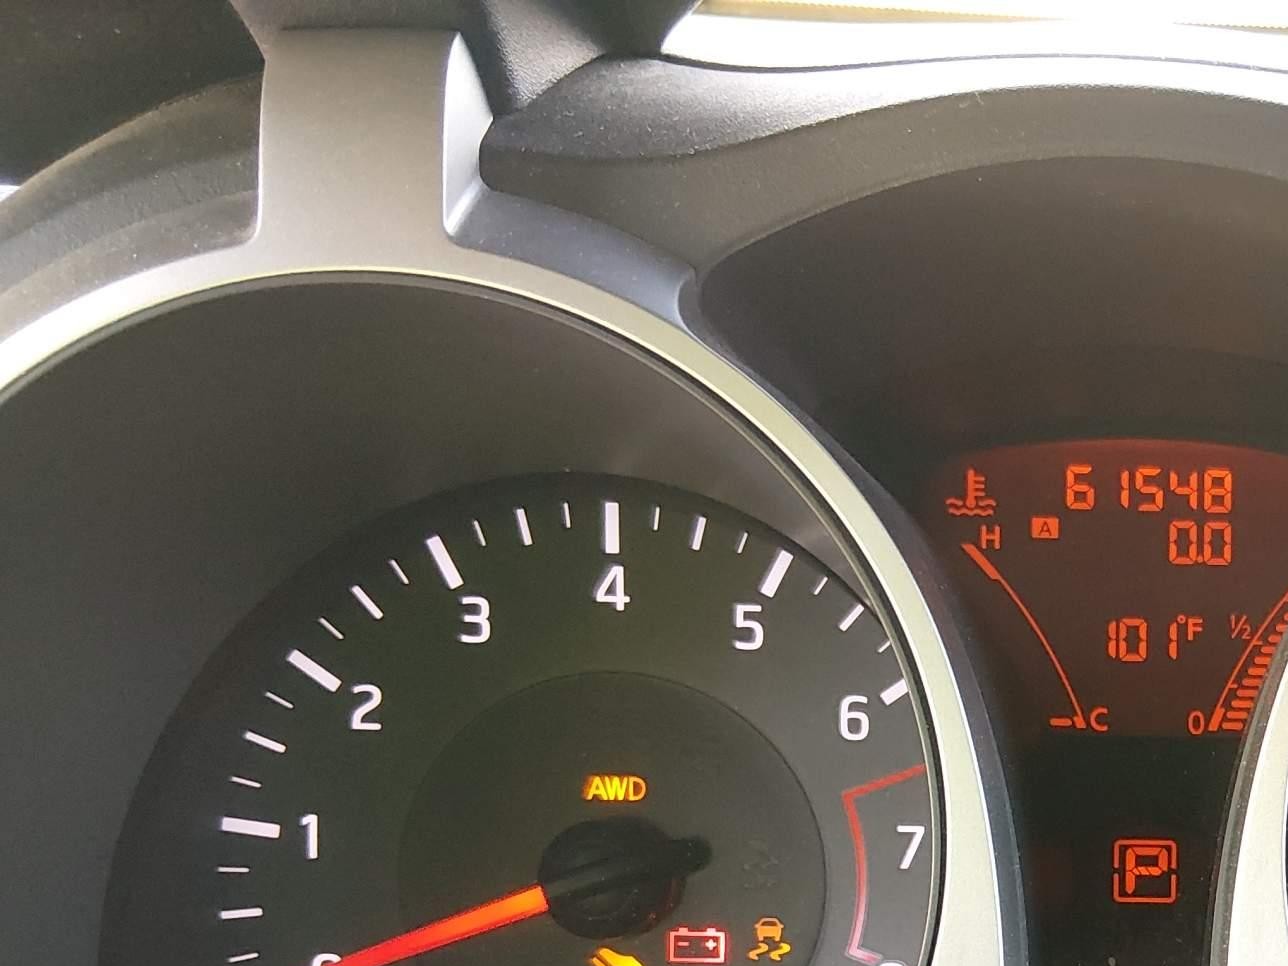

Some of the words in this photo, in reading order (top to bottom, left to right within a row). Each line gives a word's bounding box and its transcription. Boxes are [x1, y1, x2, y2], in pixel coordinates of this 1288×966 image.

[1066, 464, 1232, 513] 61548
[980, 525, 1000, 550] H
[1169, 520, 1232, 565] 0.0
[595, 565, 631, 611] 4
[458, 596, 491, 643] 3
[732, 604, 764, 650] 5
[351, 685, 383, 730] 2
[839, 695, 869, 740] 6
[1089, 708, 1108, 731] C
[1187, 711, 1204, 735] 0
[585, 775, 647, 801] AWD
[300, 814, 319, 860] 1
[896, 825, 925, 870] 7
[1125, 846, 1169, 894] P
